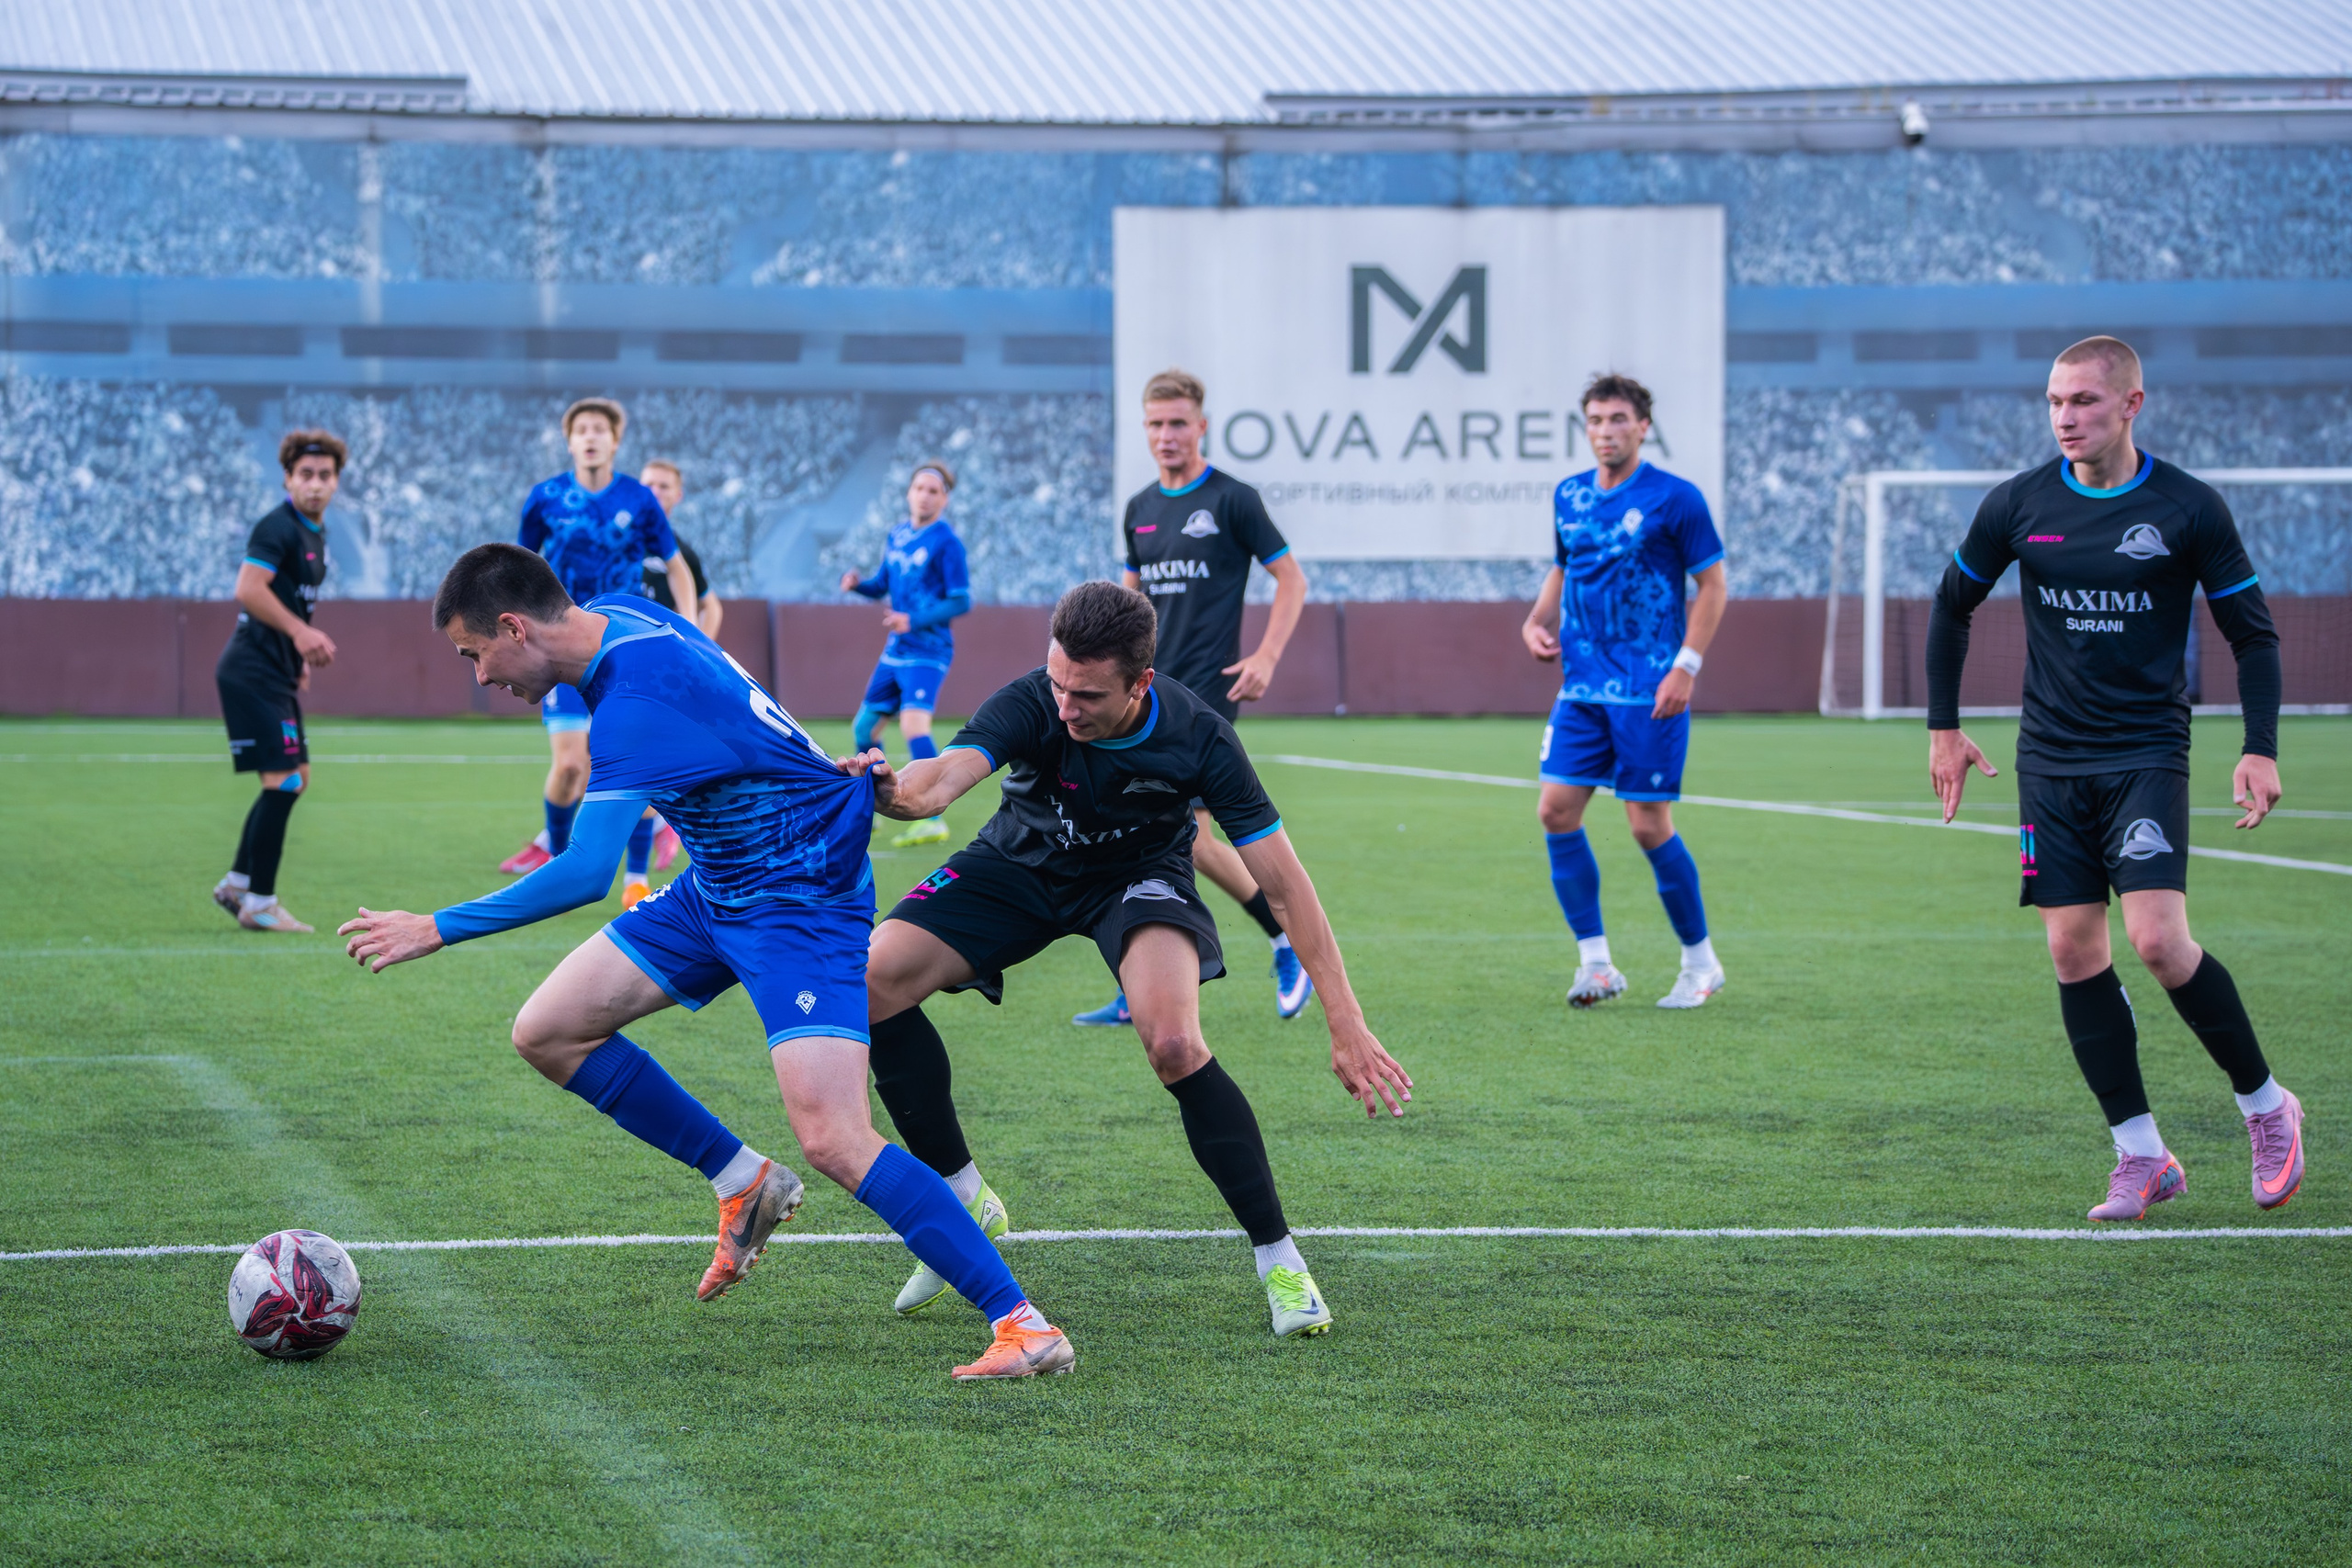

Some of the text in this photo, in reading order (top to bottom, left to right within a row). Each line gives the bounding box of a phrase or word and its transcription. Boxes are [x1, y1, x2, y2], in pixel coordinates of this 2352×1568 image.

[1253, 478, 1436, 505] ОРТИВНЫЙ
[2038, 585, 2154, 613] MAXIMA
[2065, 617, 2123, 633] SURANI
